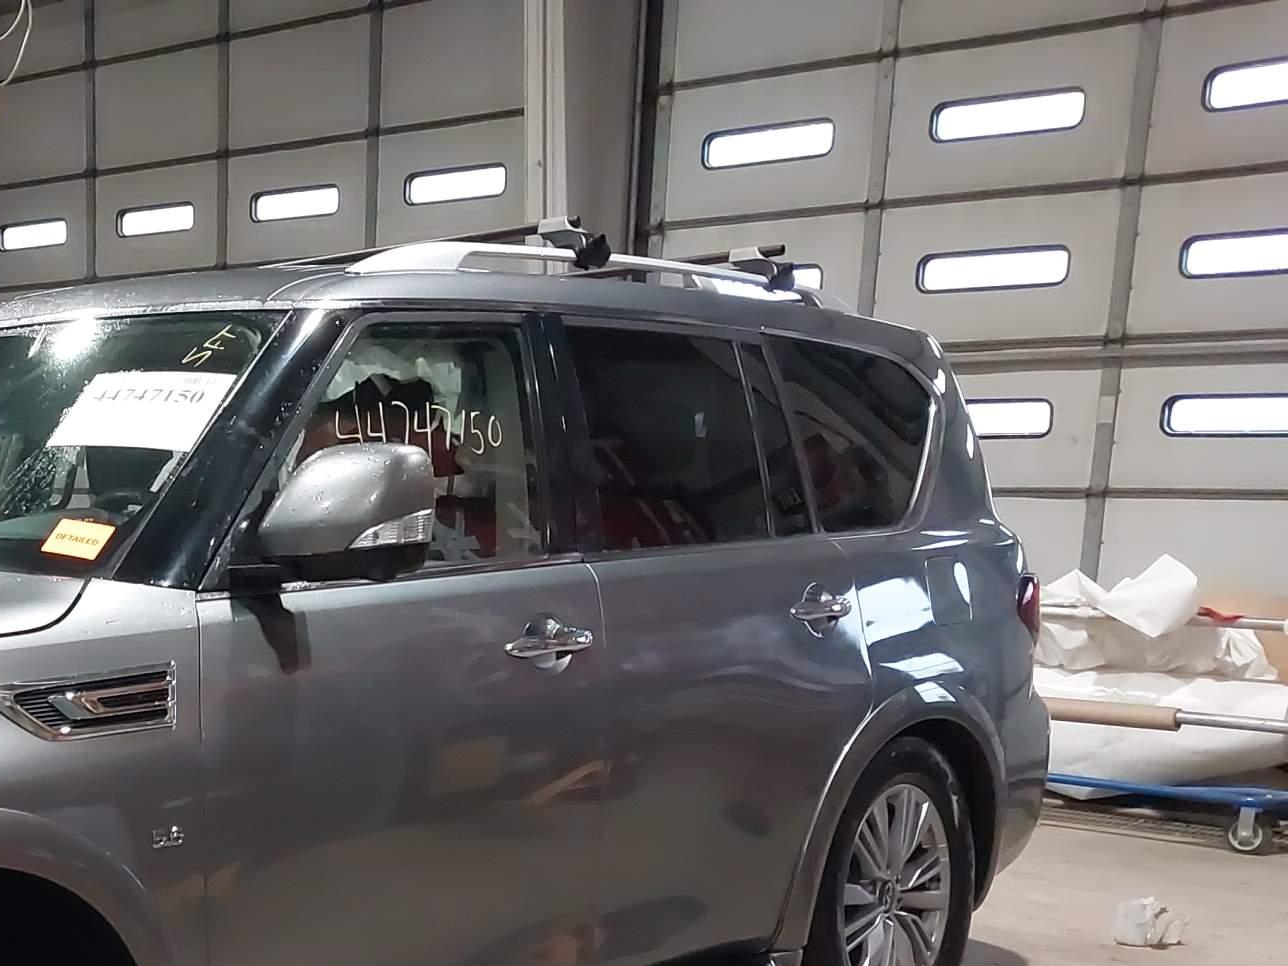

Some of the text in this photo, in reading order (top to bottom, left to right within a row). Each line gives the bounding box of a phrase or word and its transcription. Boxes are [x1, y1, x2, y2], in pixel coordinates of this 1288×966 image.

[94, 388, 206, 404] 44747150
[334, 400, 503, 464] 44747150
[54, 532, 100, 546] DETAILED
